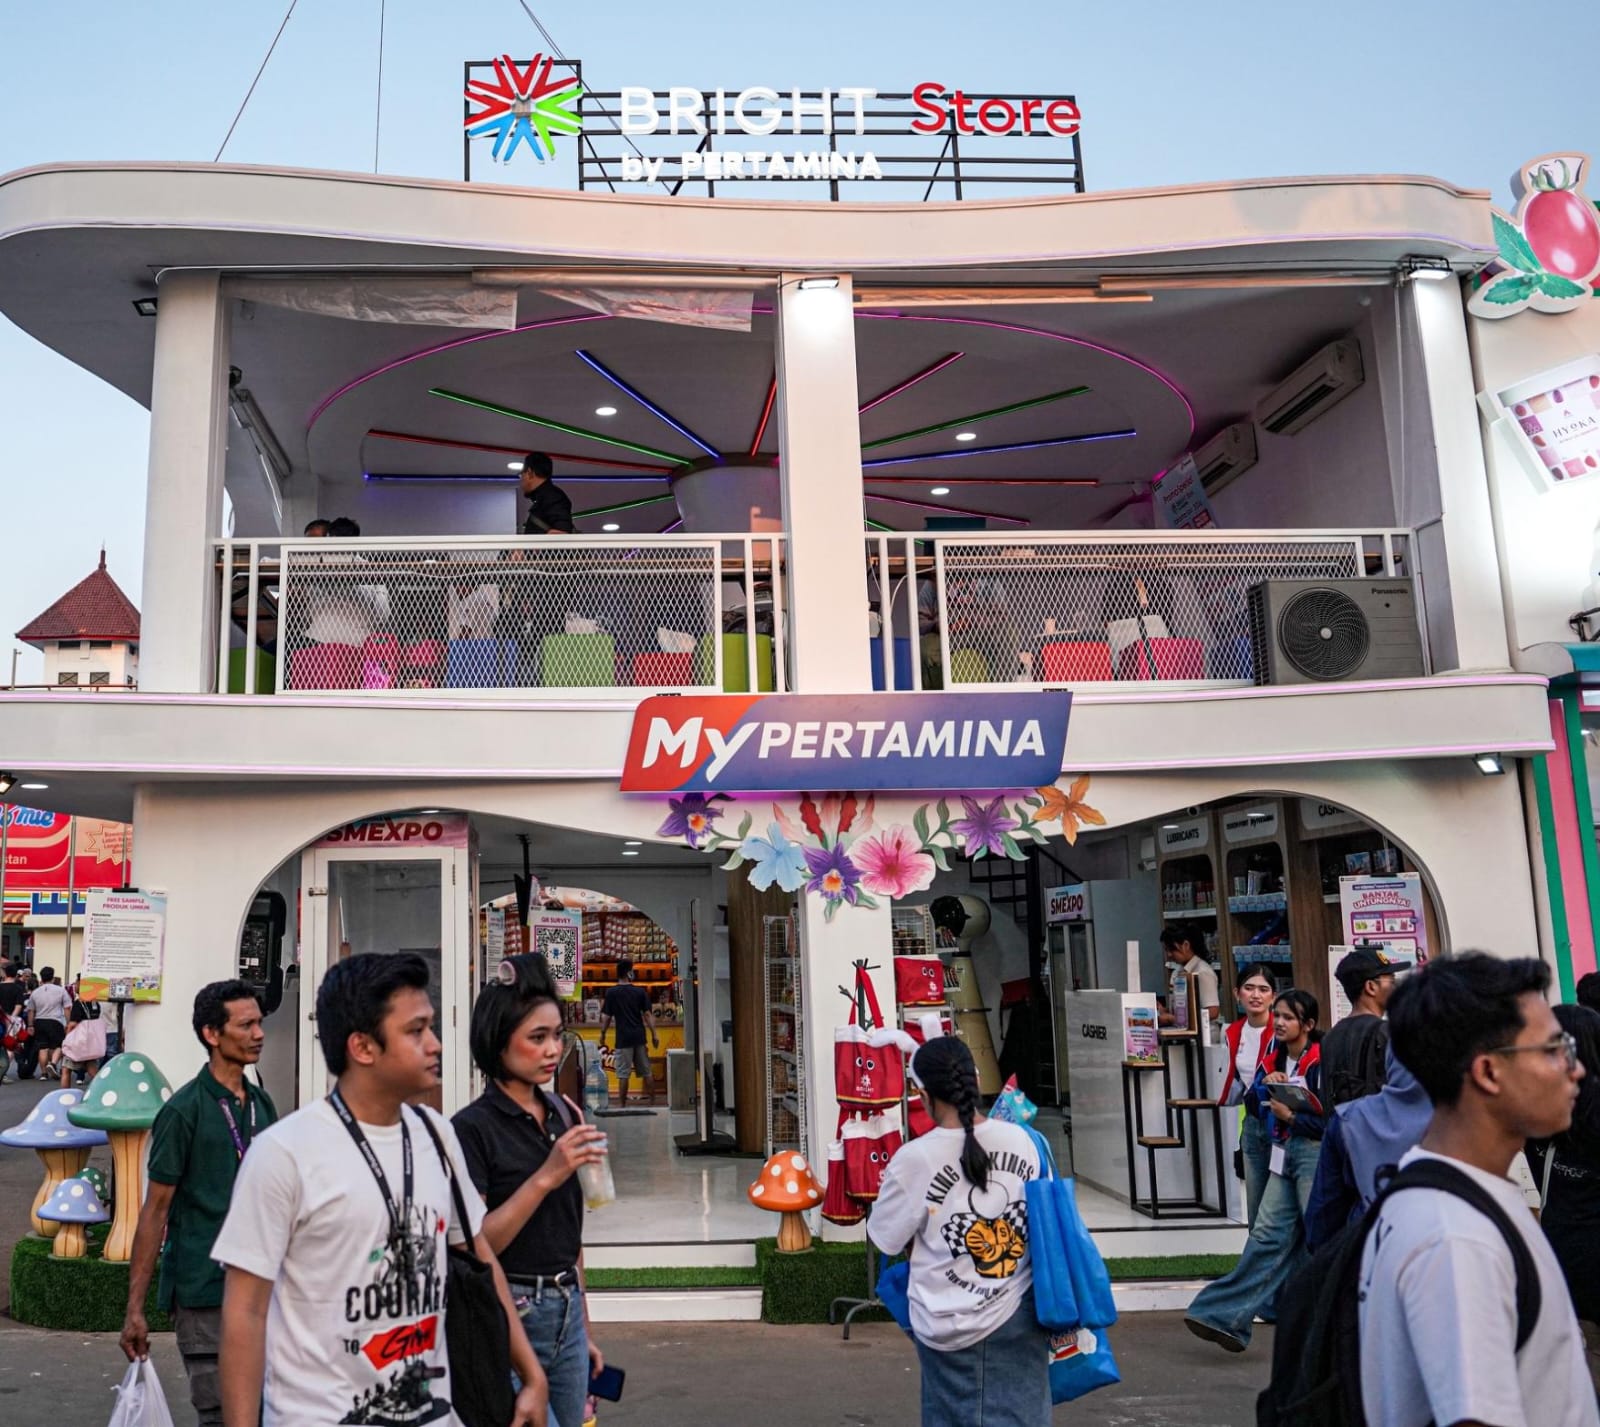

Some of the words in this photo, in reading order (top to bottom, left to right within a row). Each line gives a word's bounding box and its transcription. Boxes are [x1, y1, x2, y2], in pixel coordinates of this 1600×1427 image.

[620, 86, 878, 136] BRIGHT
[911, 82, 1081, 137] Store
[622, 156, 661, 186] by
[681, 151, 883, 181] PERTAMINA
[1371, 586, 1409, 595] Panasonic
[327, 815, 443, 842] SMEXPO
[1166, 828, 1199, 844] LUBRICANTS
[1362, 891, 1399, 900] BANYAK
[1051, 894, 1084, 915] SMEXPO
[551, 916, 571, 924] SURVEY
[1082, 1024, 1107, 1040] CASHIER
[926, 1164, 960, 1205] KING
[987, 1152, 1035, 1183] KINGS
[342, 1338, 360, 1355] TO
